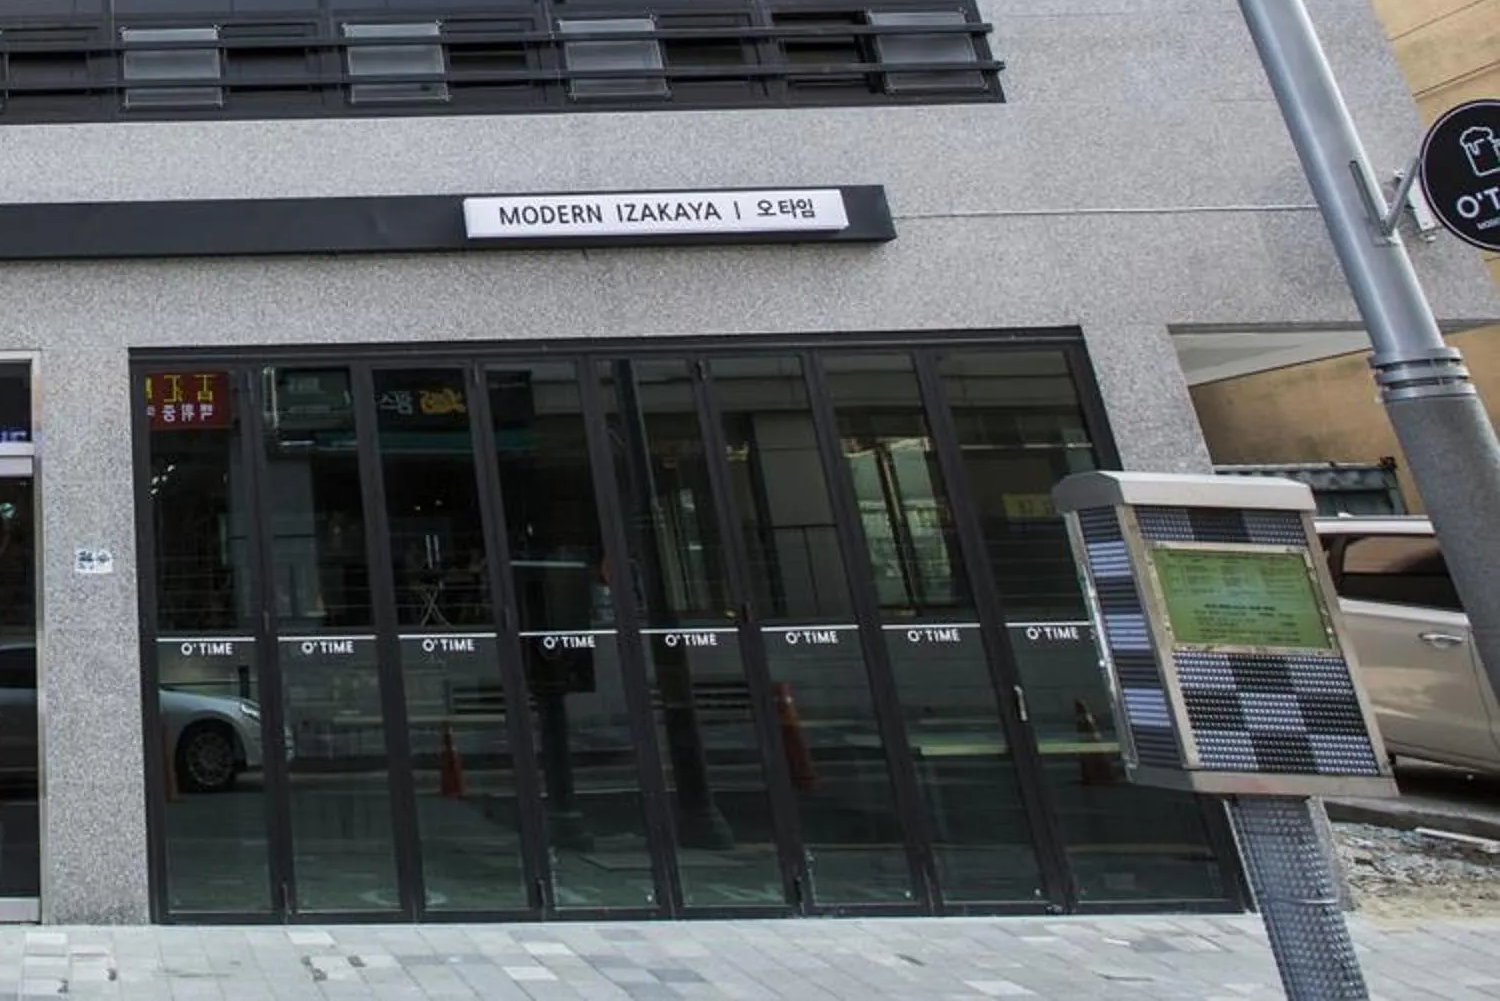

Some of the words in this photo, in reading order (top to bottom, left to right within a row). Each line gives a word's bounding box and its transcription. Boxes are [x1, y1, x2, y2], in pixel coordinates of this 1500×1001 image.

[500, 202, 603, 226] MODERN
[616, 200, 722, 223] IZAKAYA
[756, 199, 816, 219] 오타임
